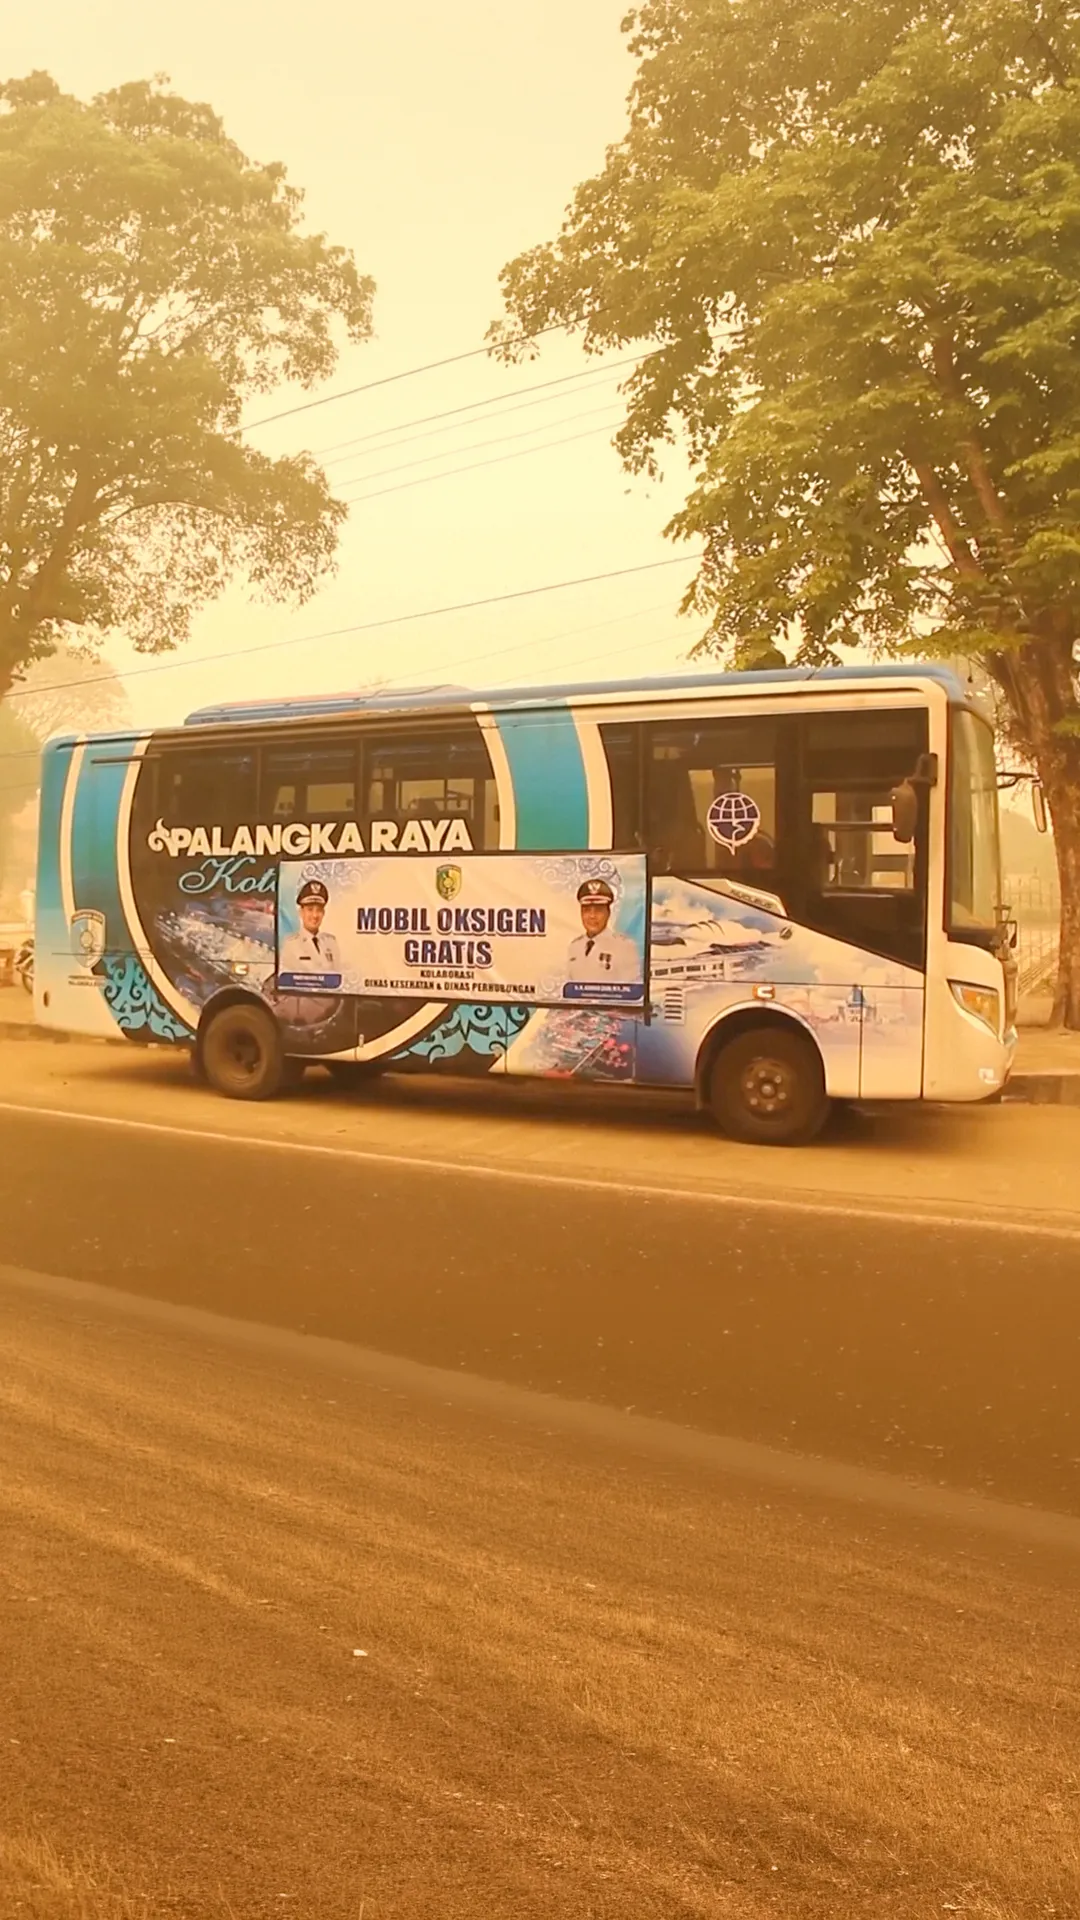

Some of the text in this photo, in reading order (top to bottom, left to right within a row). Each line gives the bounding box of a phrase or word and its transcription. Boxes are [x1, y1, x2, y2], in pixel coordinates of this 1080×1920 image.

[148, 818, 474, 857] PALANGKA RAYA
[356, 907, 547, 937] MOBIL OKSIGEN
[404, 939, 494, 969] GRATIS
[364, 978, 389, 988] DINAS
[390, 980, 435, 990] KESEHATAN
[444, 981, 471, 992] DINAS
[472, 982, 536, 994] PERHUBUNGAN
[420, 970, 475, 980] KOLABORASI
